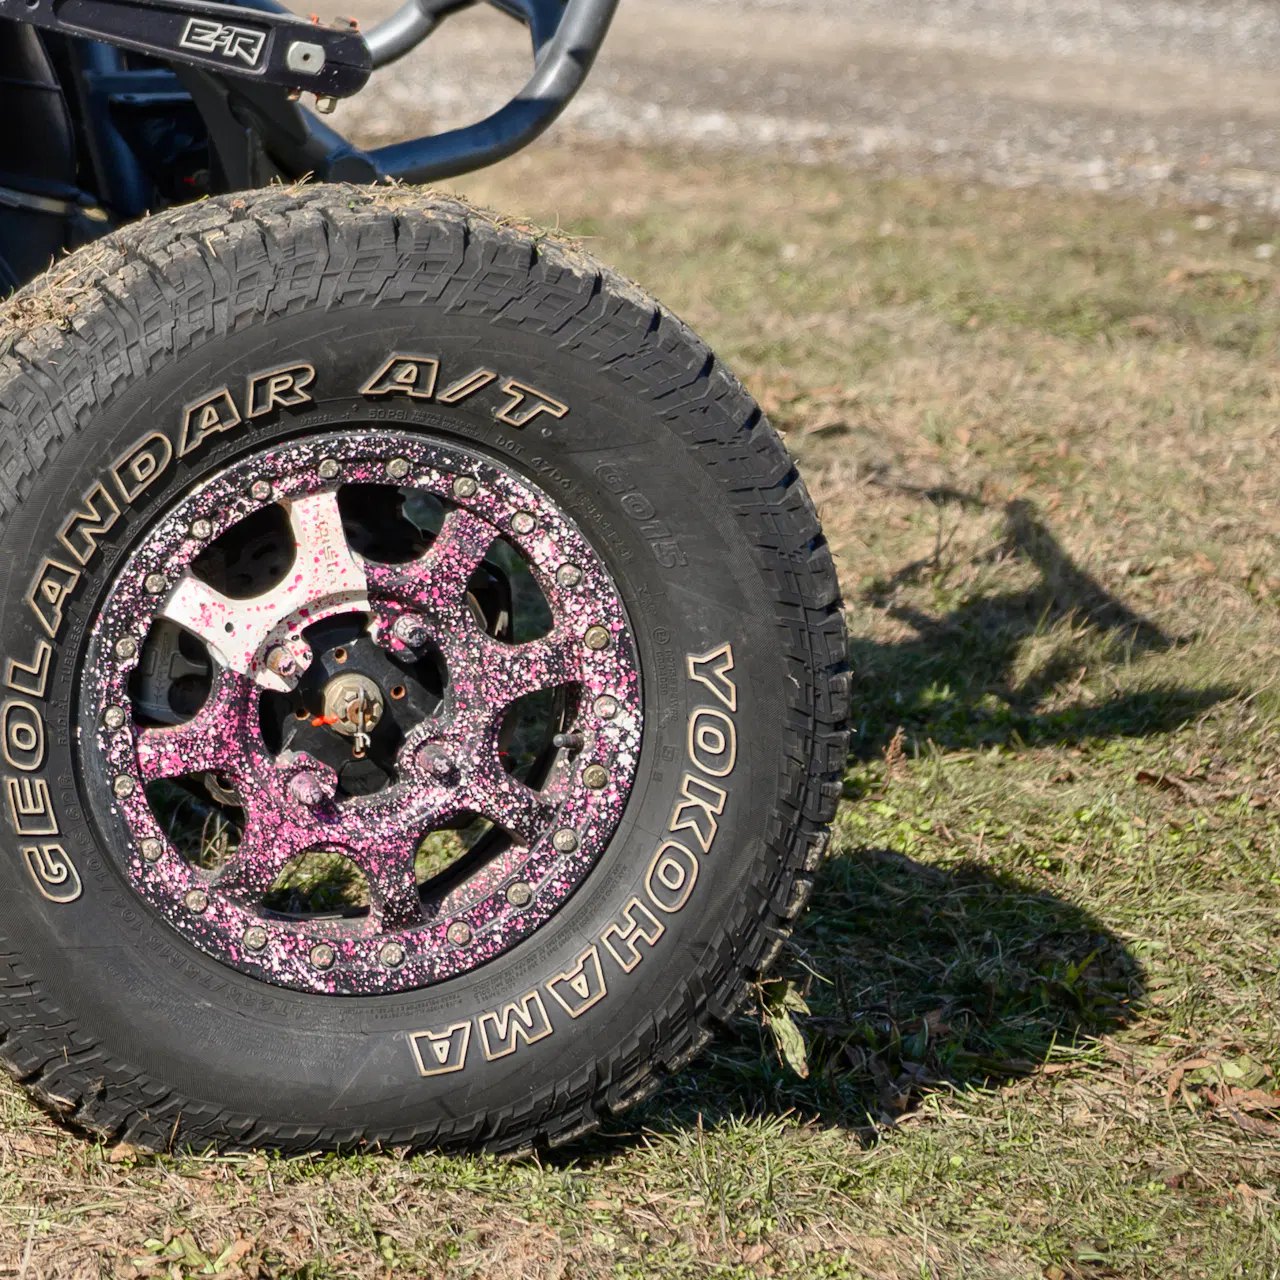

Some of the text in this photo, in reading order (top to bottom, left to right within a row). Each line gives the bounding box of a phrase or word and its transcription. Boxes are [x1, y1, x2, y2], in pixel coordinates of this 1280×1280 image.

[0, 353, 571, 905] GEOLANDAR A/T
[493, 431, 523, 456] DOT
[408, 644, 735, 1077] YOKOHAMA
